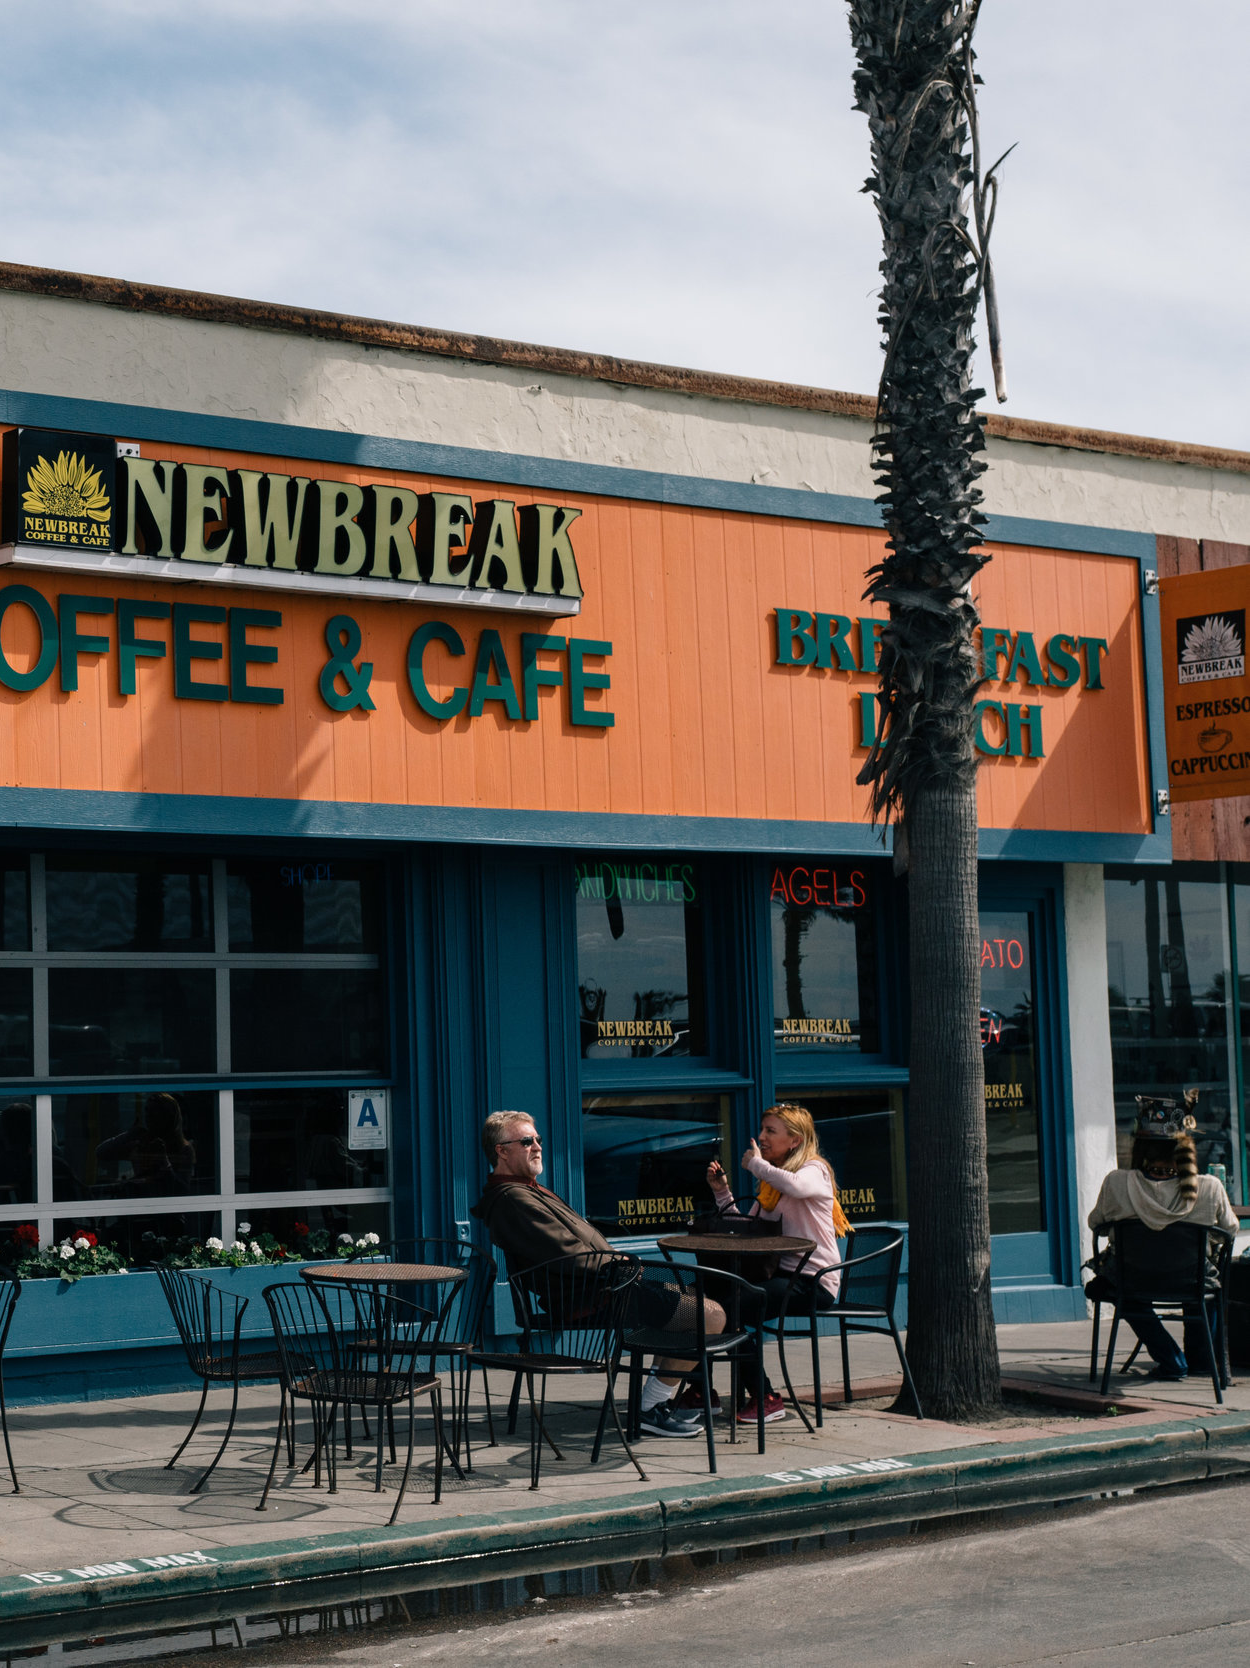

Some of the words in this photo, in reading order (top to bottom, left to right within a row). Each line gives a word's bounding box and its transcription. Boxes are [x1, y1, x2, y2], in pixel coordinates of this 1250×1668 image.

[24, 517, 111, 537] NEWBREAK
[121, 456, 584, 597] NEWBREAK
[25, 531, 67, 542] COFFEE
[70, 535, 78, 543] &
[82, 536, 110, 546] CAFE
[319, 614, 377, 713] &
[407, 621, 616, 728] CAFE
[1181, 657, 1242, 676] NEWBREAK
[597, 1020, 674, 1037] NEWBREAK
[783, 1018, 851, 1034] NEWBREAK
[597, 1038, 637, 1046] COFFEE
[648, 1037, 675, 1046] CAFE
[357, 1098, 378, 1127] A
[618, 1196, 694, 1216] NEWBREAK
[853, 1205, 876, 1213] CAFE
[618, 1217, 657, 1226] COFFEE
[765, 1471, 803, 1482] 15
[799, 1465, 856, 1478] MIN
[849, 1458, 913, 1472] MAX
[19, 1571, 63, 1584] 15
[69, 1562, 138, 1579] MIN
[139, 1551, 218, 1569] MAX
